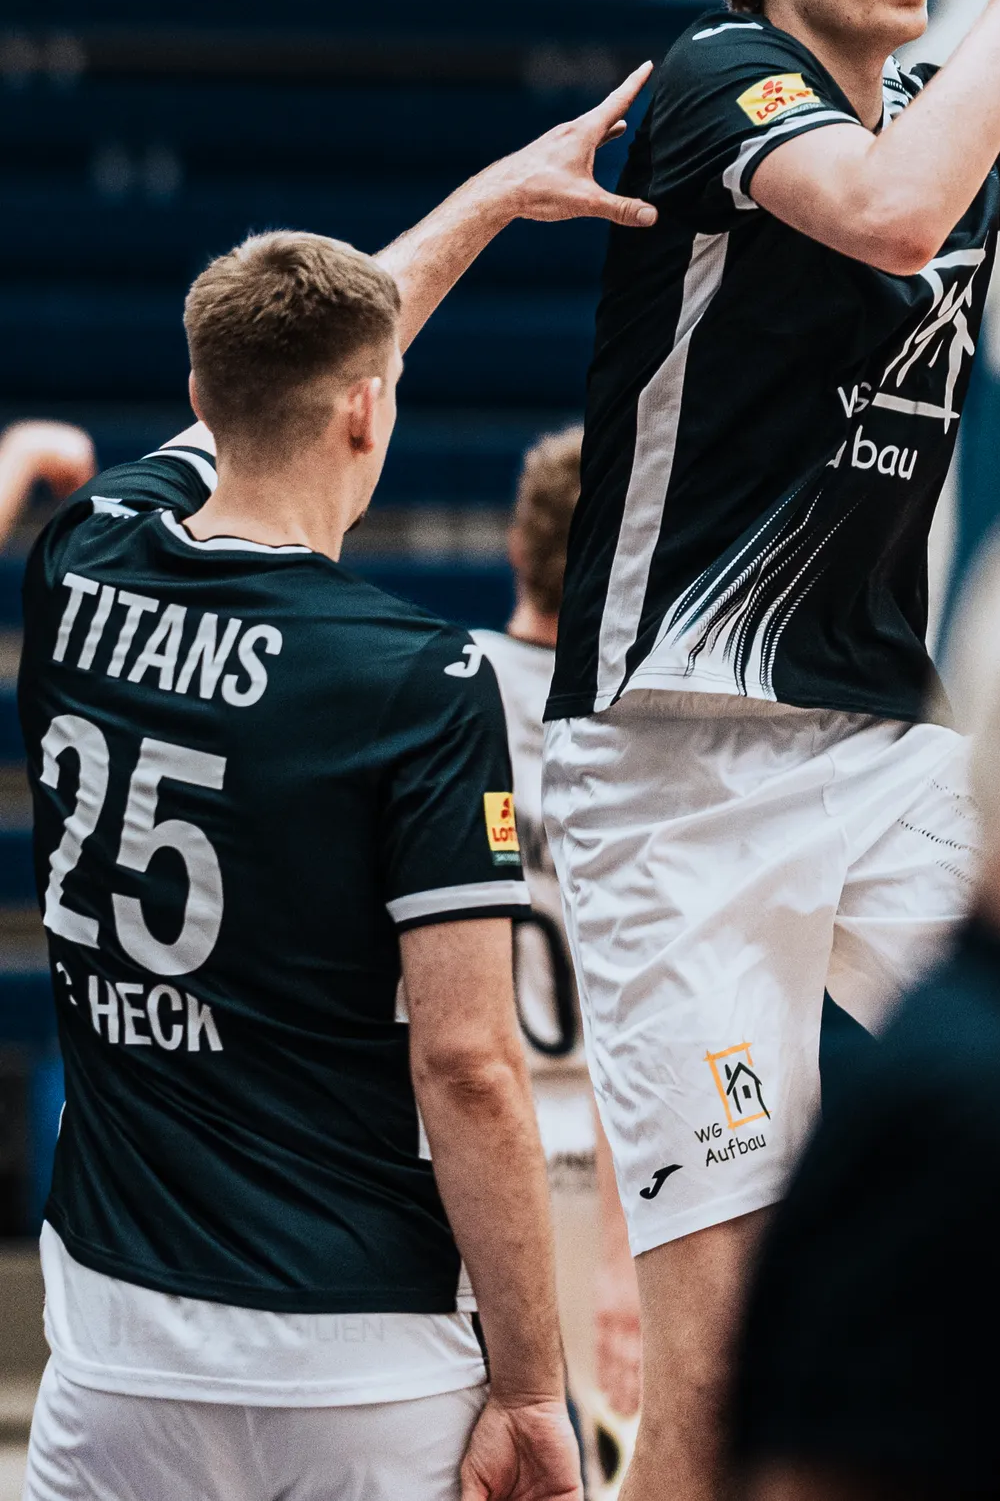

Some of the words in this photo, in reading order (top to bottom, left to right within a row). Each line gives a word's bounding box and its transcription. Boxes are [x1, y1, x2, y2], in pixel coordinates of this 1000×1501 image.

[52, 572, 283, 707] TITANS
[39, 714, 227, 976] 25
[88, 974, 223, 1051] HECK
[694, 1123, 723, 1143] WG
[706, 1134, 767, 1167] Aufbau
